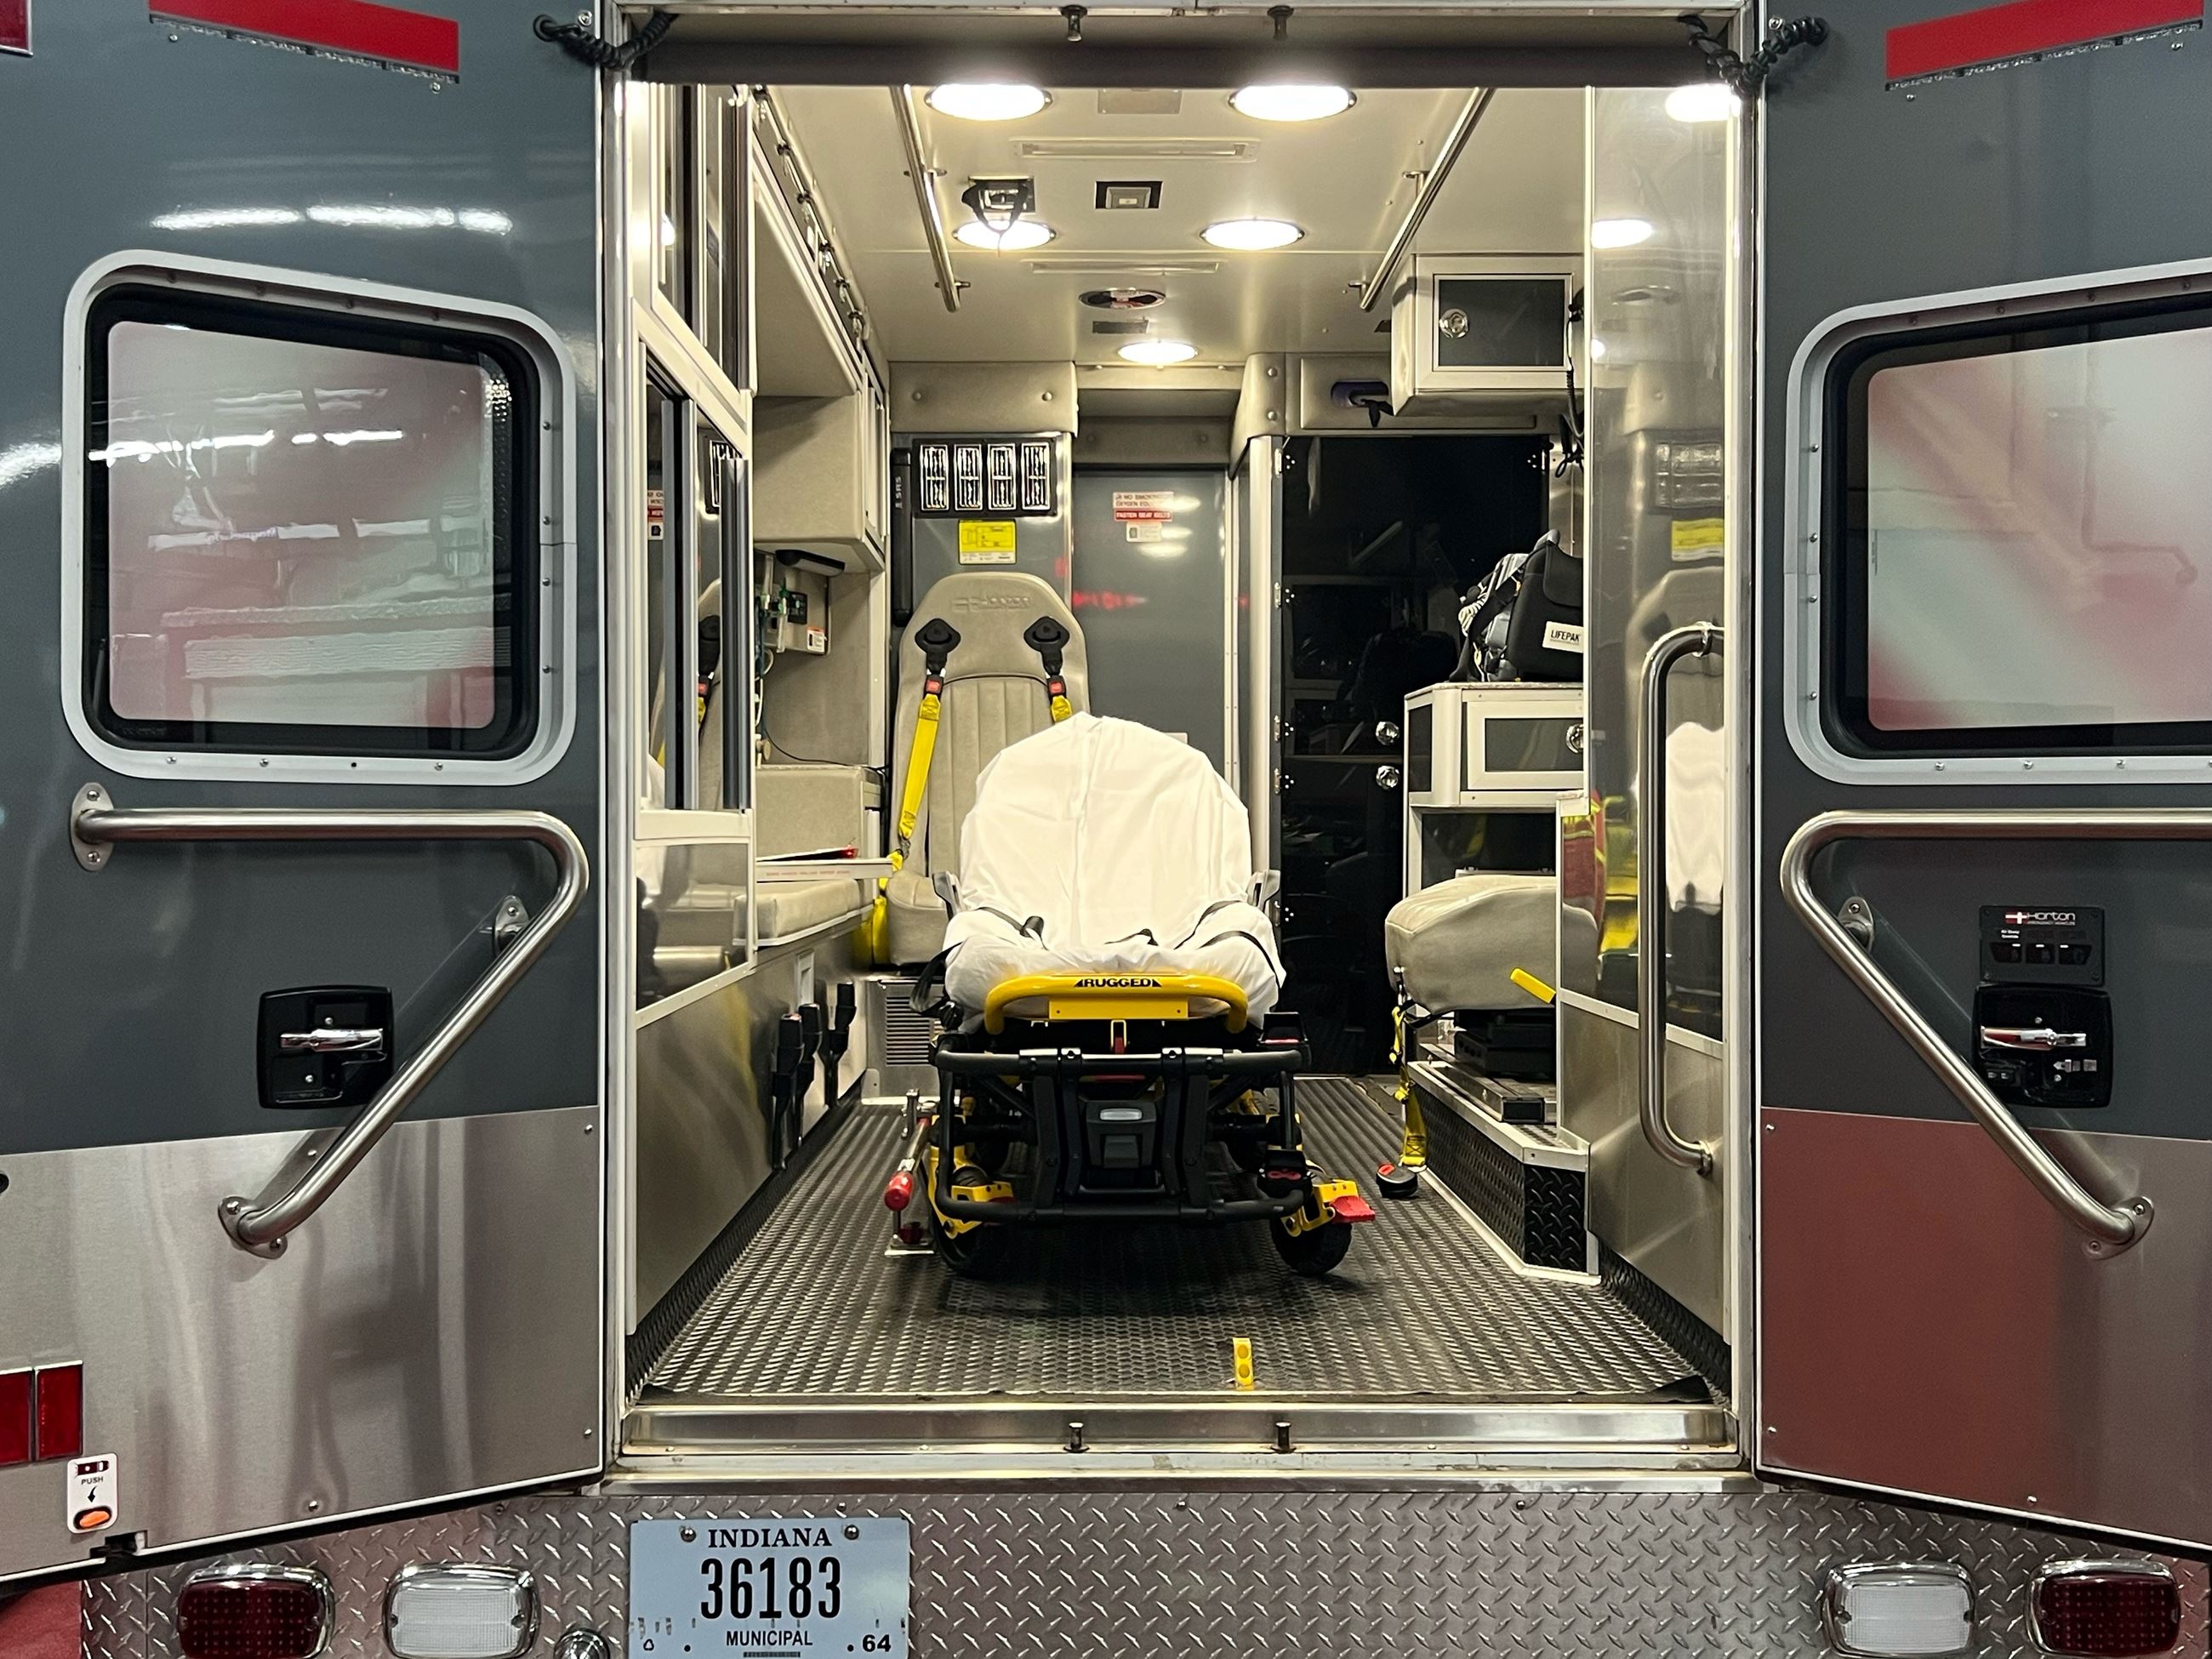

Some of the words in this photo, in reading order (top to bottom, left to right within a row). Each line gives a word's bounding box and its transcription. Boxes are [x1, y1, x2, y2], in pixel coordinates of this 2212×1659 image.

[1550, 629, 1581, 642] LIFEPAK
[2027, 911, 2076, 921] Horton
[1084, 978, 1151, 988] RUGGED
[81, 1476, 104, 1485] PUSH
[708, 1528, 833, 1548] INDIANA
[700, 1556, 841, 1619] 36183
[726, 1630, 813, 1646] MUNICIPAL
[862, 1634, 892, 1653] 64
